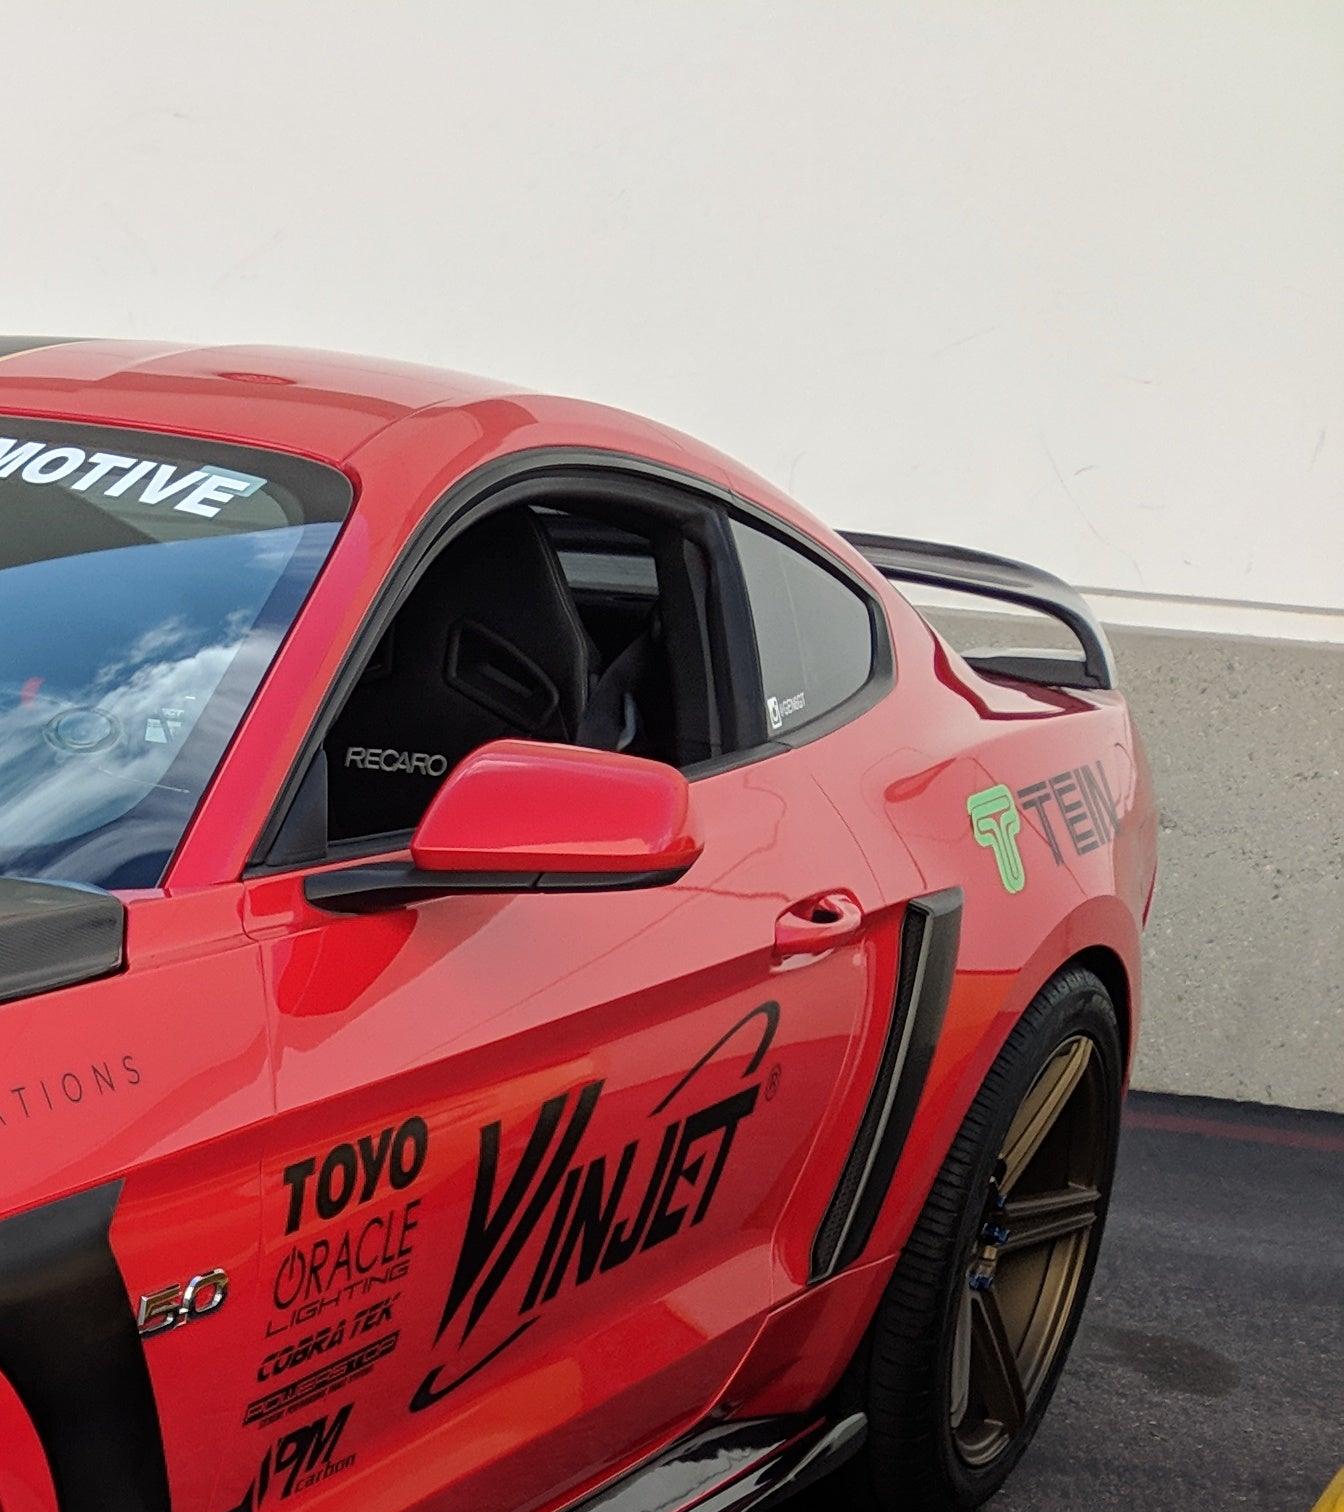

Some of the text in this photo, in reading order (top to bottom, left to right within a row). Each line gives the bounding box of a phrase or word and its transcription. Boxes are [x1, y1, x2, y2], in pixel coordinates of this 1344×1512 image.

[344, 746, 447, 777] RECARO
[1016, 759, 1120, 866] TEIN
[283, 1115, 428, 1236] TOYO
[272, 1197, 421, 1311] ORACLE
[137, 1266, 229, 1336] 5.0
[264, 1258, 410, 1340] LIGHTING
[294, 1453, 357, 1495] carbon
